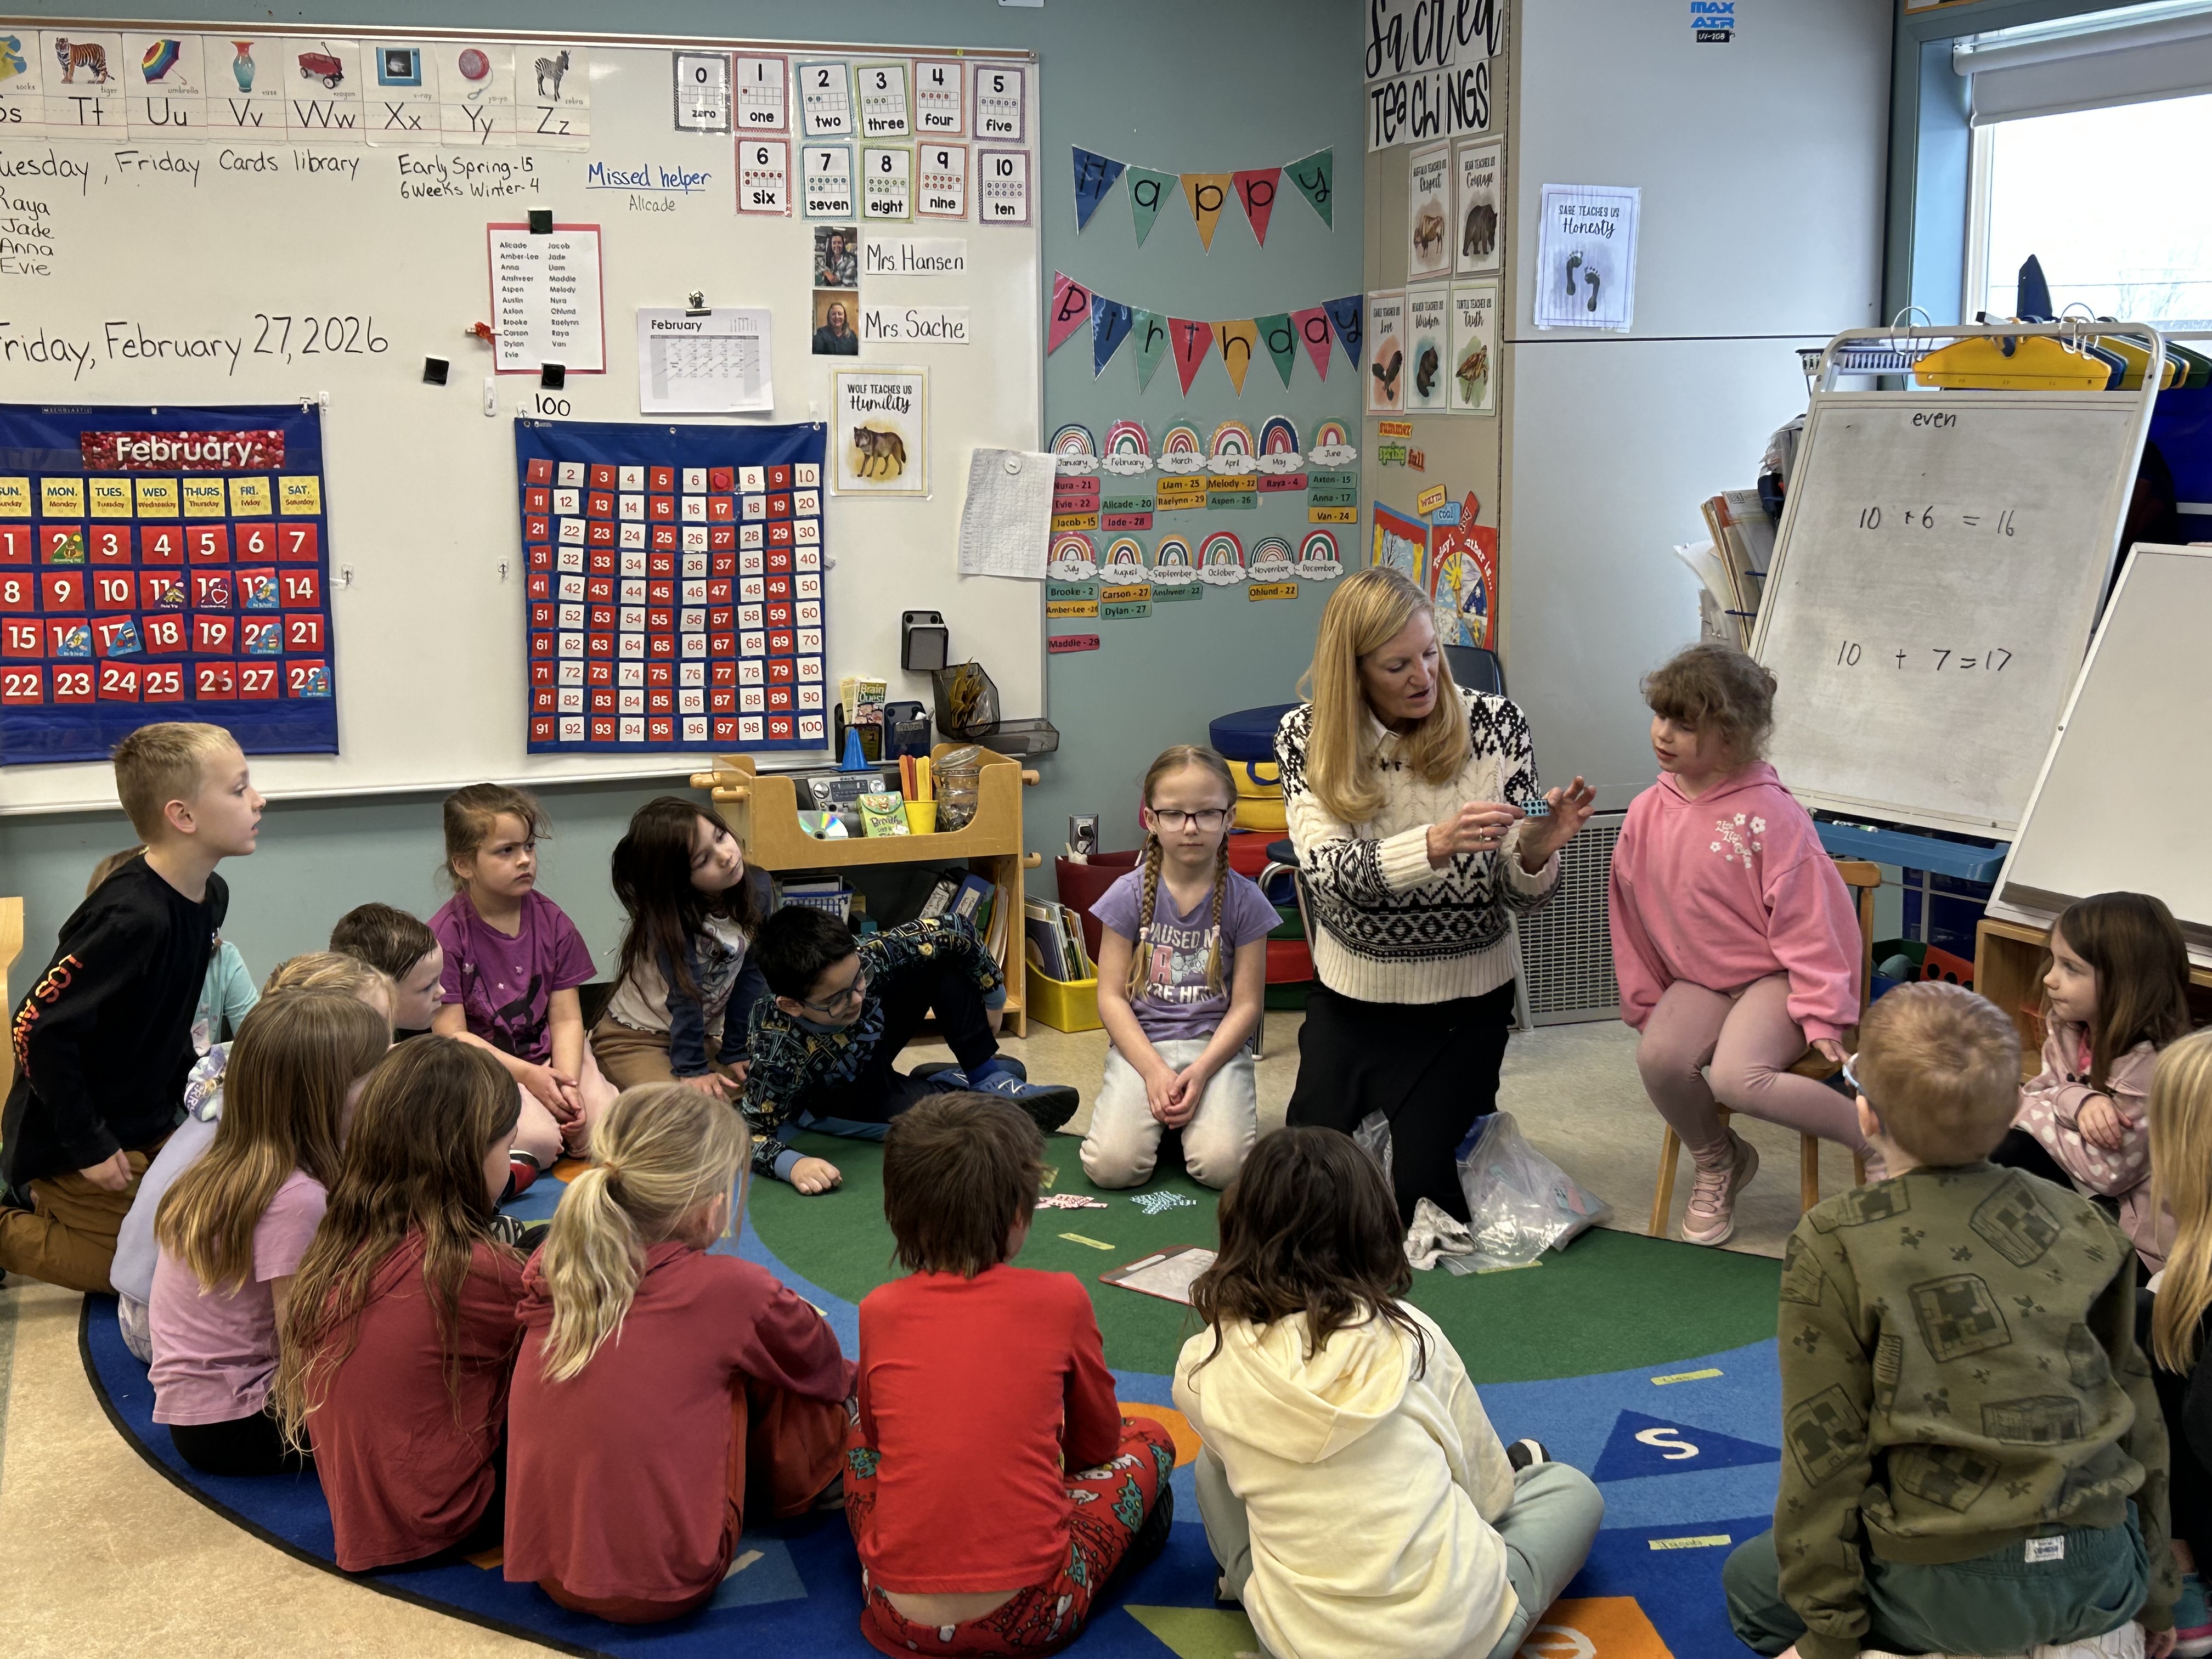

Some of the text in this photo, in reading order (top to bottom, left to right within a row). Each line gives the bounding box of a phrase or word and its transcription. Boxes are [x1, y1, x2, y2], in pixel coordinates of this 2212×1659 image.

[1690, 2, 1735, 14] MAX
[1690, 16, 1735, 29] AIR
[818, 70, 829, 88] 2
[876, 72, 887, 89] 3
[932, 69, 944, 86] 4
[993, 76, 1005, 93] 5
[69, 97, 103, 126] Tt
[146, 97, 187, 126] Uu
[229, 98, 263, 127] Vv
[294, 100, 356, 128] Ww
[385, 102, 422, 130] Xx
[692, 109, 716, 120] zero
[749, 110, 774, 123] one
[924, 112, 953, 126] four
[461, 105, 493, 145] Yy
[537, 106, 571, 135] Zz
[815, 114, 842, 128] two
[868, 117, 905, 131] three
[757, 148, 769, 165] 6
[820, 153, 832, 171] 7
[881, 155, 892, 172] 8
[936, 151, 949, 169] 9
[115, 150, 200, 188] Friday
[219, 149, 278, 171] Cards
[294, 149, 359, 181] library
[398, 153, 449, 183] Early
[996, 159, 1013, 176] 10
[588, 161, 712, 194] Missed helper
[753, 189, 775, 205] six
[809, 199, 849, 212] seven
[929, 196, 956, 210] nine
[871, 199, 903, 214] eight
[994, 202, 1015, 216] ten
[1579, 206, 1608, 217] TEACHES
[1611, 207, 1620, 217] US
[2, 218, 55, 239] Jade
[1564, 217, 1616, 239] Honesty
[0, 236, 54, 256] Anna
[0, 256, 51, 276] Evie
[867, 244, 964, 271] Mrs. Hansen
[651, 319, 702, 333] February
[865, 309, 964, 338] Mrs. Sache
[105, 321, 241, 376] February
[847, 383, 912, 395] WOLF TEACHES US
[535, 393, 571, 416] 100
[850, 394, 911, 414] Humility
[1912, 413, 1957, 428] even
[116, 436, 252, 466] February
[1171, 456, 1193, 465] March
[567, 469, 814, 483] 2 10
[47, 487, 77, 496] MON.
[95, 487, 125, 497] TUES.
[143, 488, 170, 497] WED.
[184, 487, 221, 496] THURS.
[560, 496, 815, 509] 12 20
[1317, 512, 1331, 521] Van
[1859, 506, 1881, 529] 10
[1998, 510, 2015, 537] 16
[102, 531, 305, 556] 3 4 5 7
[594, 528, 673, 544] 23 25
[716, 559, 731, 569] 37
[100, 577, 313, 602] 10 14
[802, 607, 818, 618] 60
[1105, 606, 1129, 616] Dylan
[8, 623, 227, 649] 15 19
[803, 635, 819, 646] 70
[1838, 641, 1861, 667] 10
[146, 669, 273, 693] 25 27
[651, 669, 667, 680] 75
[714, 695, 730, 705] 87
[536, 721, 822, 734] 91 100
[1634, 1427, 1700, 1460] S
